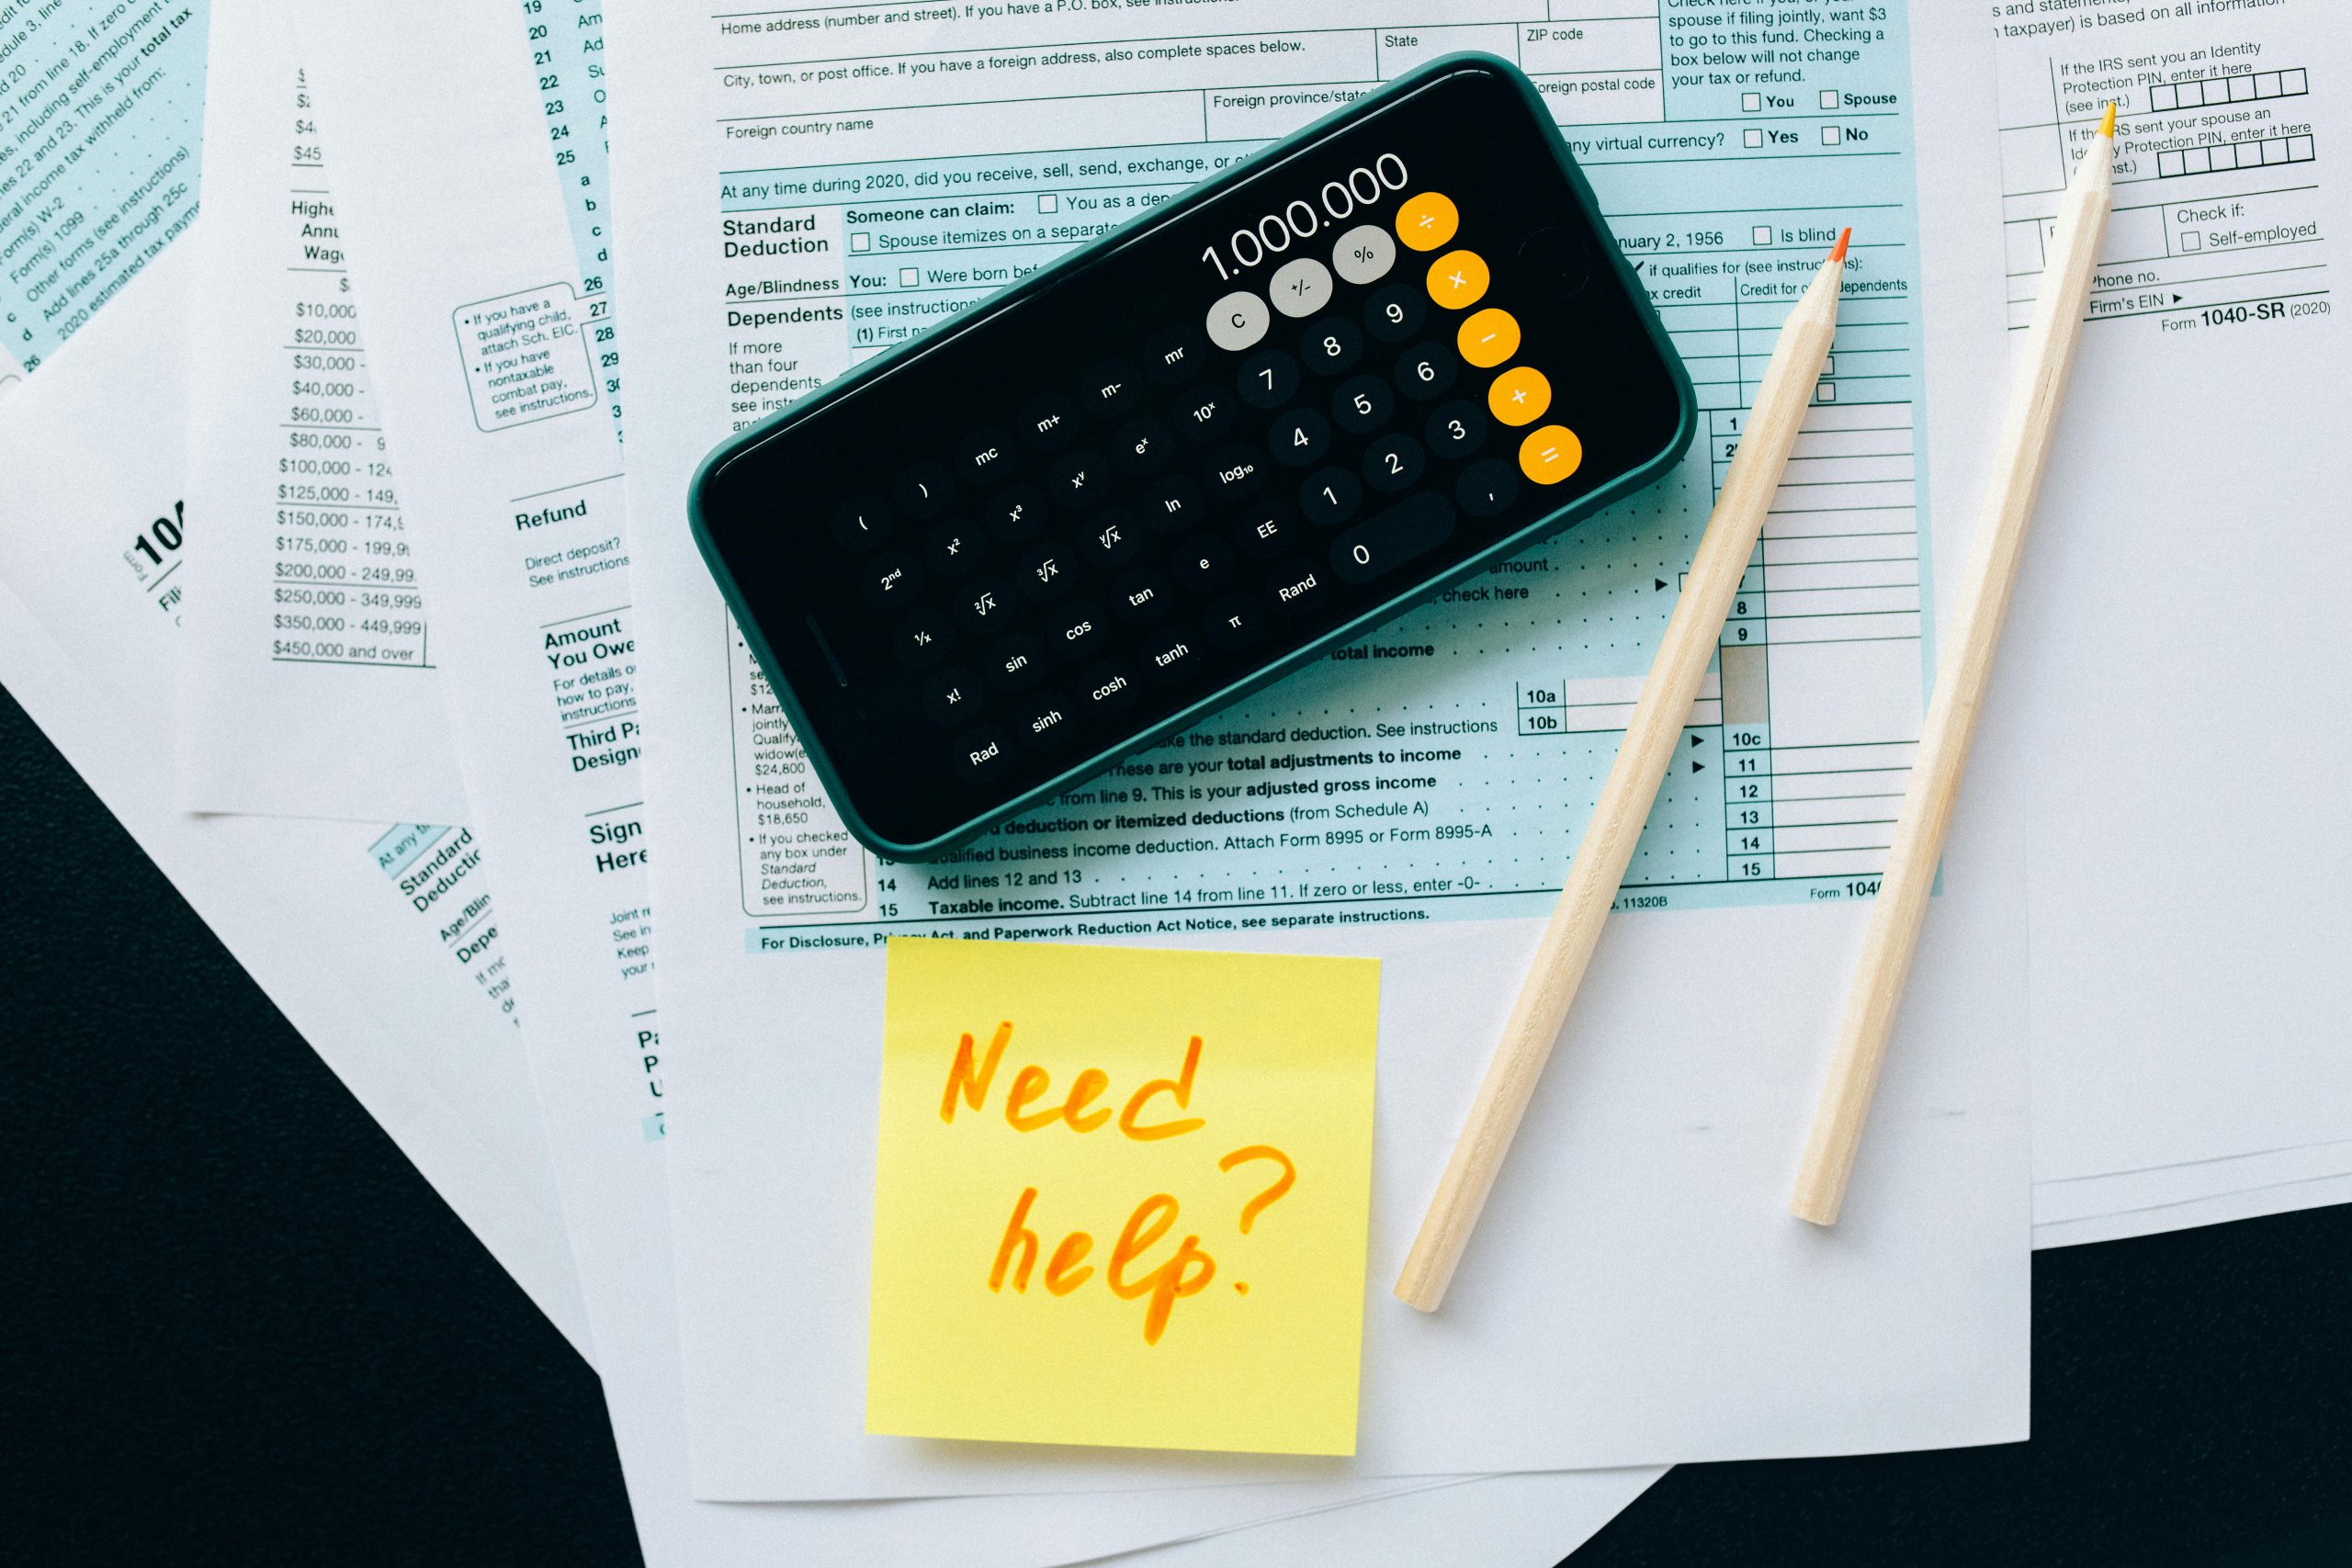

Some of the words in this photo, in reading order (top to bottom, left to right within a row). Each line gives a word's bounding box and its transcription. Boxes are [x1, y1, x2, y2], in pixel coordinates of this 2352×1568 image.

[1668, 15, 1723, 30] spouse
[1726, 11, 1736, 26] if
[1738, 10, 1774, 28] filing
[1778, 8, 1825, 27] jointly,
[1829, 8, 1865, 22] want
[1868, 6, 1887, 22] $3
[140, 25, 173, 58] total
[168, 6, 194, 30] tax
[527, 24, 548, 41] 20
[1385, 34, 1419, 48] State
[1526, 28, 1548, 42] ZIP
[1552, 27, 1584, 41] code
[1668, 34, 1685, 47] to
[1689, 35, 1708, 50] go
[1711, 32, 1727, 45] to
[1730, 30, 1758, 45] this
[1761, 28, 1799, 44] fund.
[1803, 28, 1871, 44] Checking
[1875, 29, 1885, 41] a
[533, 49, 552, 66] 21
[723, 73, 755, 90] City,
[758, 73, 797, 85] town,
[799, 72, 815, 82] or
[817, 67, 849, 84] post
[852, 64, 894, 79] office.
[898, 62, 907, 75] If
[910, 62, 936, 78] you
[939, 60, 973, 73] have
[976, 60, 986, 70] a
[988, 56, 1037, 71] foreign
[1041, 51, 1101, 66] address,
[1104, 49, 1134, 62] also
[1136, 44, 1203, 62] complete
[1205, 43, 1256, 59] spaces
[1259, 39, 1306, 53] below.
[1670, 52, 1699, 67] box
[1702, 51, 1747, 66] below
[1750, 49, 1775, 63] will
[1779, 49, 1804, 62] not
[1806, 48, 1860, 64] change
[2060, 62, 2070, 77] If
[2072, 62, 2095, 75] the
[2098, 57, 2124, 73] IRS
[2127, 53, 2158, 69] sent
[2160, 52, 2186, 68] you
[2189, 50, 2207, 62] an
[2210, 41, 2262, 59] Identity
[538, 73, 560, 92] 22
[1670, 74, 1705, 90] your
[1707, 72, 1732, 85] tax
[1735, 73, 1751, 85] or
[1754, 68, 1805, 84] refund.
[2063, 76, 2133, 96] Protection
[2137, 71, 2167, 86] PIN,
[2170, 68, 2206, 82] enter
[2209, 64, 2219, 77] it
[2221, 62, 2253, 76] here
[544, 99, 565, 117] 23
[1765, 95, 1794, 108] You
[1843, 93, 1897, 108] Spouse
[549, 124, 571, 141] 24
[726, 125, 777, 141] Foreign
[781, 121, 832, 136] country
[836, 119, 875, 131] name
[1767, 130, 1799, 144] Yes
[1845, 127, 1869, 141] No
[555, 149, 576, 167] 25
[845, 209, 925, 225] Someone
[929, 207, 960, 220] can
[964, 201, 1015, 217] claim:
[1202, 152, 1408, 280] 1.000.000
[2177, 205, 2228, 224] Check
[2231, 202, 2245, 218] if:
[722, 213, 816, 237] Standard
[2209, 221, 2317, 247] Self-employed
[724, 236, 829, 259] Deduction
[1354, 246, 1374, 263] %
[724, 278, 840, 299] Age/Blindness
[848, 274, 887, 289] You:
[1386, 304, 1403, 322] 9
[2089, 297, 2135, 315] Firm's
[2138, 292, 2165, 309] EIN
[727, 305, 843, 330] Dependents
[1232, 314, 1245, 328] C
[2161, 318, 2197, 333] Form
[2200, 301, 2286, 327] 1040-SR
[2290, 300, 2331, 320] (2020)
[1165, 347, 1183, 364] mr
[1324, 337, 1340, 355] 8
[483, 360, 493, 374] If
[495, 357, 519, 375] you
[520, 349, 550, 365] have
[1418, 362, 1434, 381] 6
[487, 363, 555, 389] nontaxable
[1259, 369, 1272, 389] 7
[491, 383, 538, 404] combat
[540, 378, 568, 395] pay,
[1354, 394, 1371, 414] 5
[1037, 415, 1059, 432] m+
[1449, 421, 1465, 439] 3
[1295, 428, 1308, 446] 4
[976, 448, 998, 466] mc
[1385, 454, 1403, 474] 2
[1324, 487, 1337, 504] 1
[514, 499, 588, 532] Refund
[1165, 500, 1181, 513] ln
[1257, 521, 1277, 538] EE
[524, 551, 564, 571] Direct
[566, 536, 621, 561] deposit?
[1353, 546, 1369, 564] 0
[528, 573, 555, 589] See
[557, 555, 631, 581] instructions
[1200, 559, 1209, 569] e
[1129, 589, 1153, 605] tan
[1279, 574, 1317, 601] Rand
[1736, 600, 1747, 615] 8
[544, 617, 623, 650] Amount
[1067, 622, 1091, 639] cos
[1737, 626, 1748, 642] 9
[272, 640, 345, 658] $450,000
[347, 645, 378, 660] and
[380, 649, 415, 661] over
[548, 650, 588, 671] You
[592, 639, 636, 660] Owe
[1156, 644, 1188, 666] tanh
[1006, 656, 1027, 671] sin
[1093, 677, 1126, 700] cosh
[1526, 689, 1556, 705] 10a
[1033, 711, 1062, 732] sinh
[1527, 715, 1558, 730] 10b
[1732, 732, 1761, 747] 10c
[970, 742, 999, 765] Rad
[1738, 758, 1756, 773] 11
[755, 782, 789, 795] Head
[793, 781, 806, 795] of
[1739, 784, 1758, 799] 12
[756, 795, 826, 810] household,
[757, 811, 808, 827] $18,650
[589, 820, 643, 846] Sign
[1740, 835, 1761, 852] 14
[398, 826, 474, 897] Standard
[1741, 862, 1761, 877] 15
[876, 877, 898, 893] 14
[926, 874, 960, 891] Add
[963, 874, 1001, 889] lines
[1004, 872, 1023, 887] 12
[1028, 870, 1058, 886] and
[1063, 869, 1082, 884] 13
[941, 1020, 1204, 1141] Need
[988, 1145, 1297, 1344] help?
